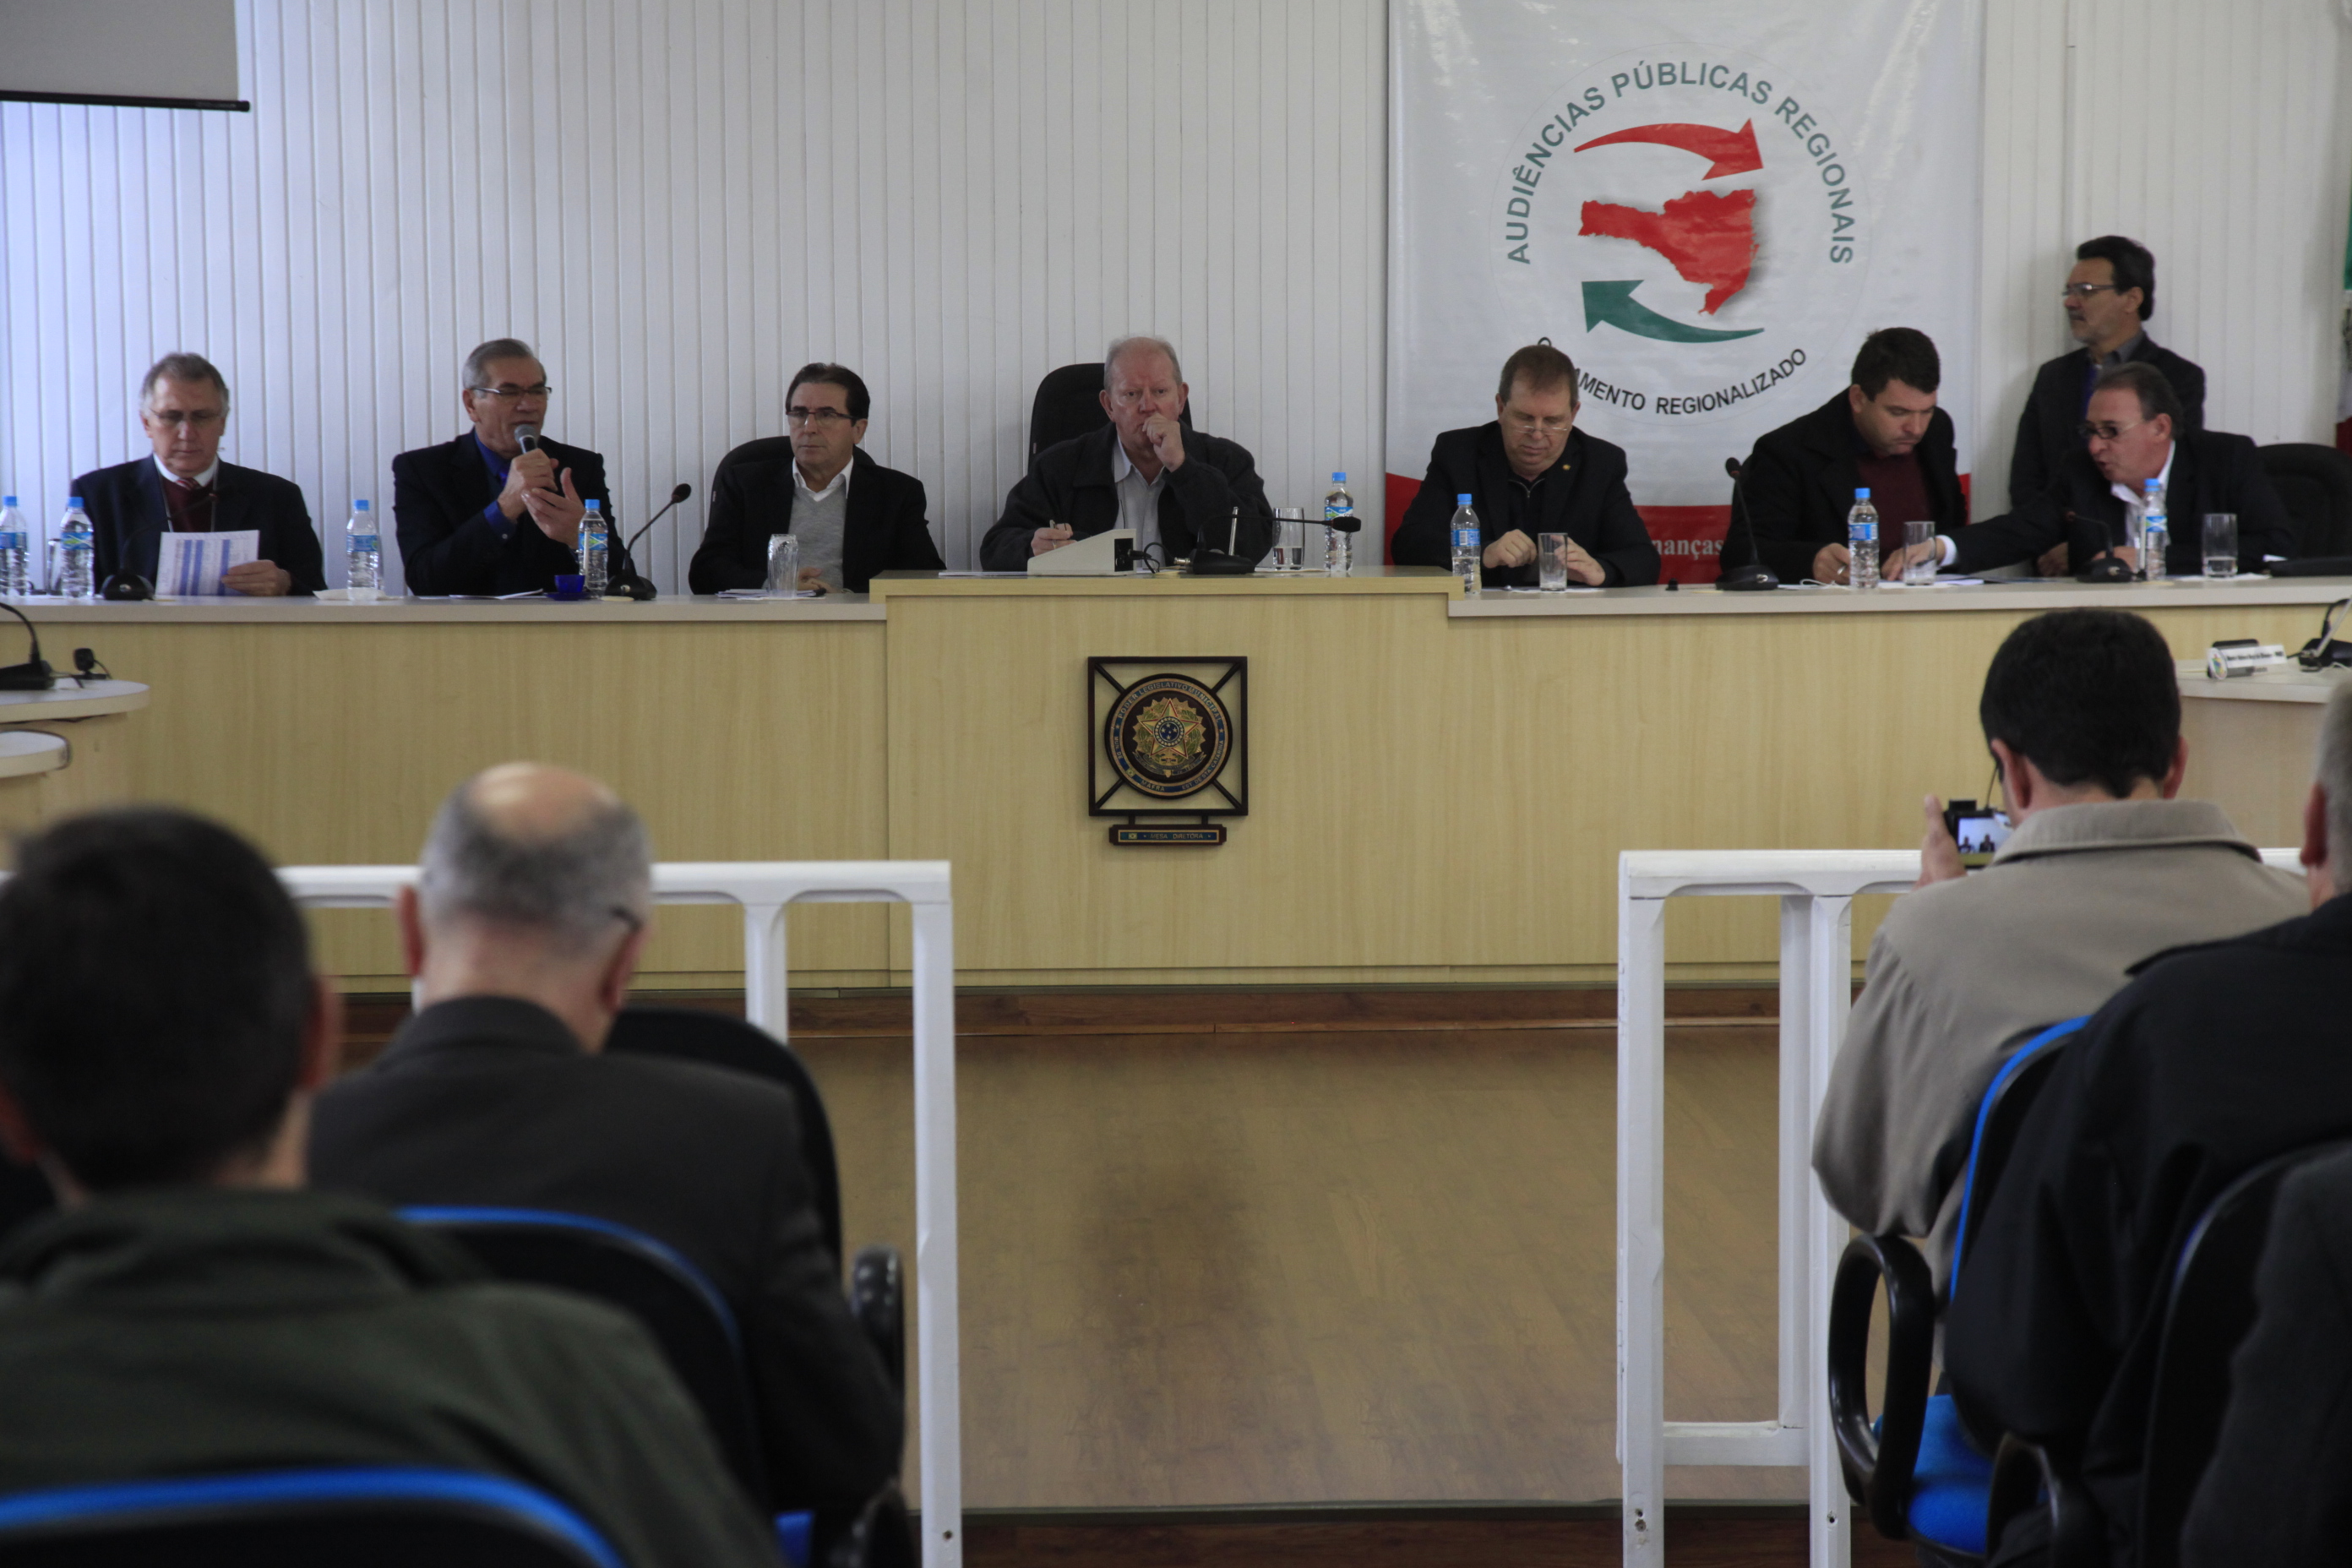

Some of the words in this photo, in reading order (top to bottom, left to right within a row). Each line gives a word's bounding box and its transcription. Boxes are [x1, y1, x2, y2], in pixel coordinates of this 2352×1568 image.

[1505, 86, 1605, 264] AUDIÊNCIAS
[1611, 60, 1772, 104] PÚBLICAS
[1774, 95, 1855, 264] REGIONAIS
[1656, 348, 1806, 415] REGIONALIZADO
[1652, 539, 1723, 560] nanças
[1118, 694, 1139, 719] PODER
[1139, 682, 1188, 694] LEGISLATIVO
[1188, 685, 1222, 723] MUNICIPAL
[1211, 740, 1224, 768] CATARINA
[1141, 779, 1165, 792] MAFRA
